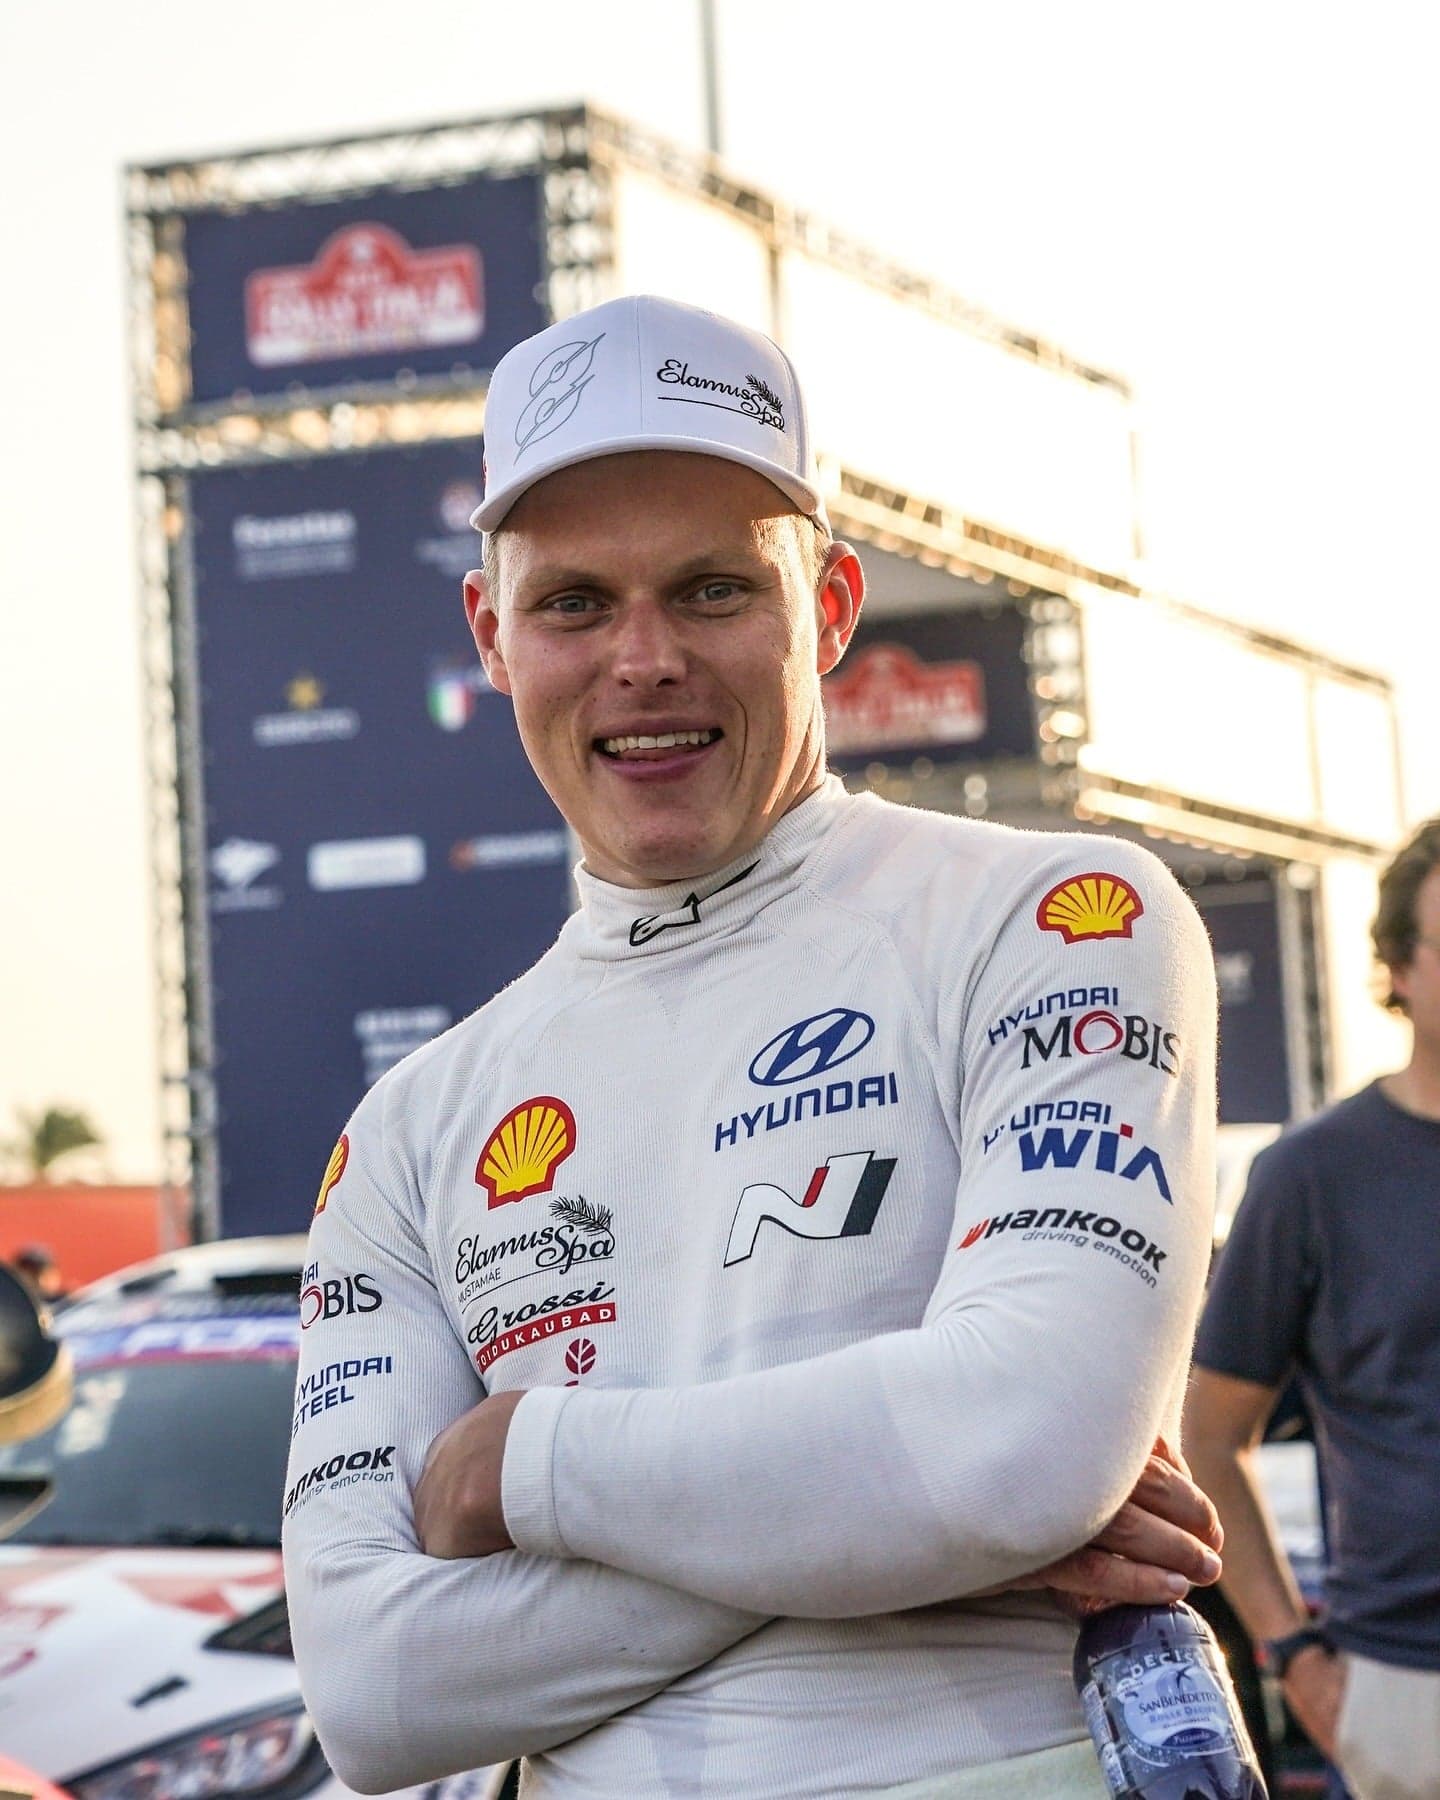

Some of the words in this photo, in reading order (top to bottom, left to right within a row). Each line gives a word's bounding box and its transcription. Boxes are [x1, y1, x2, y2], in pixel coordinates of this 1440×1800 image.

[988, 987, 1119, 1046] HYUNDAI
[1020, 1010, 1181, 1078] MOBIS
[715, 1072, 899, 1153] HYUNDAI
[1022, 1230, 1089, 1248] driving
[1093, 1240, 1158, 1289] emotion
[301, 1273, 383, 1330] OBIS
[298, 1356, 392, 1402] YUNDAI
[285, 1446, 396, 1516] ANKOOK
[330, 1472, 394, 1490] emotion
